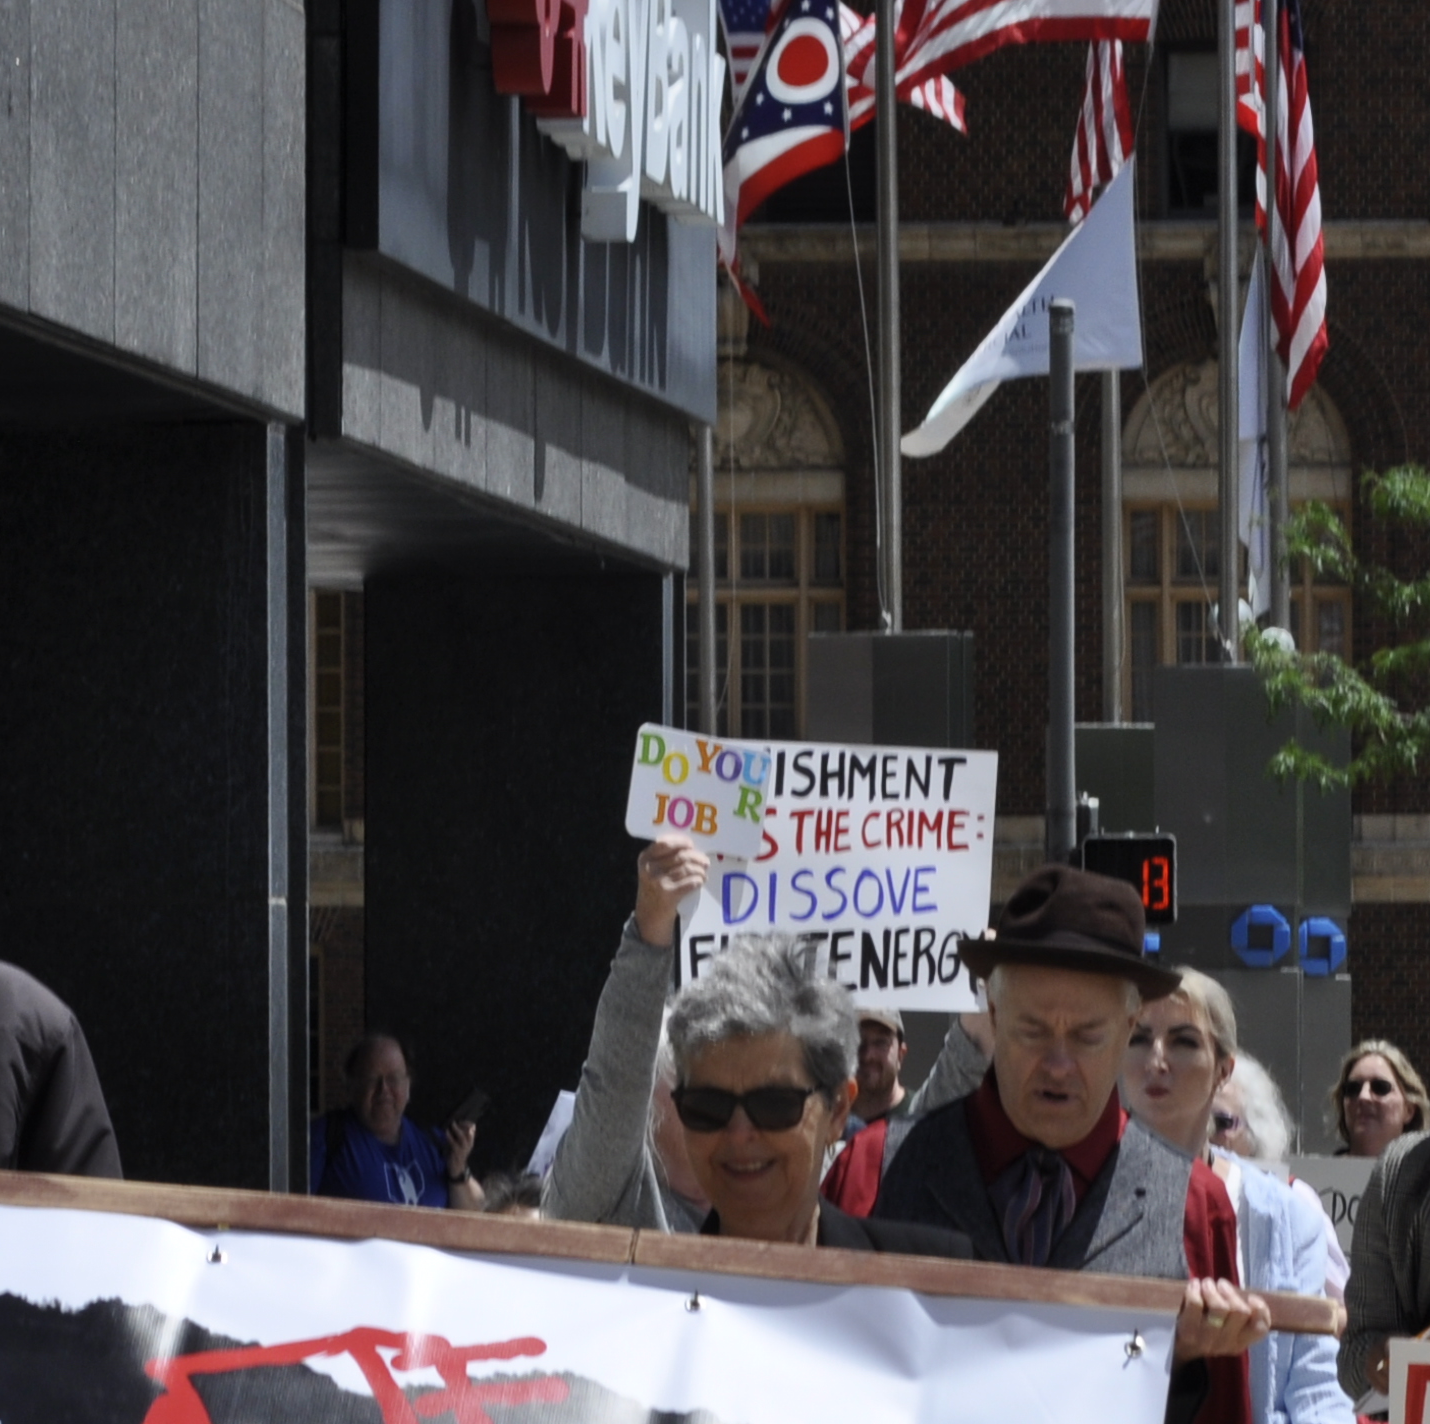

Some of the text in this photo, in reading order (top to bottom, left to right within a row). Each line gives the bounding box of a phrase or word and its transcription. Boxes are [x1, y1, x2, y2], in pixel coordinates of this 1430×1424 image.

[638, 732, 689, 785] DO
[773, 749, 967, 803] ISHMENT
[653, 792, 718, 836] JOB
[789, 808, 850, 855] THE
[721, 866, 938, 926] DISSOVE
[1142, 856, 1170, 910] 13
